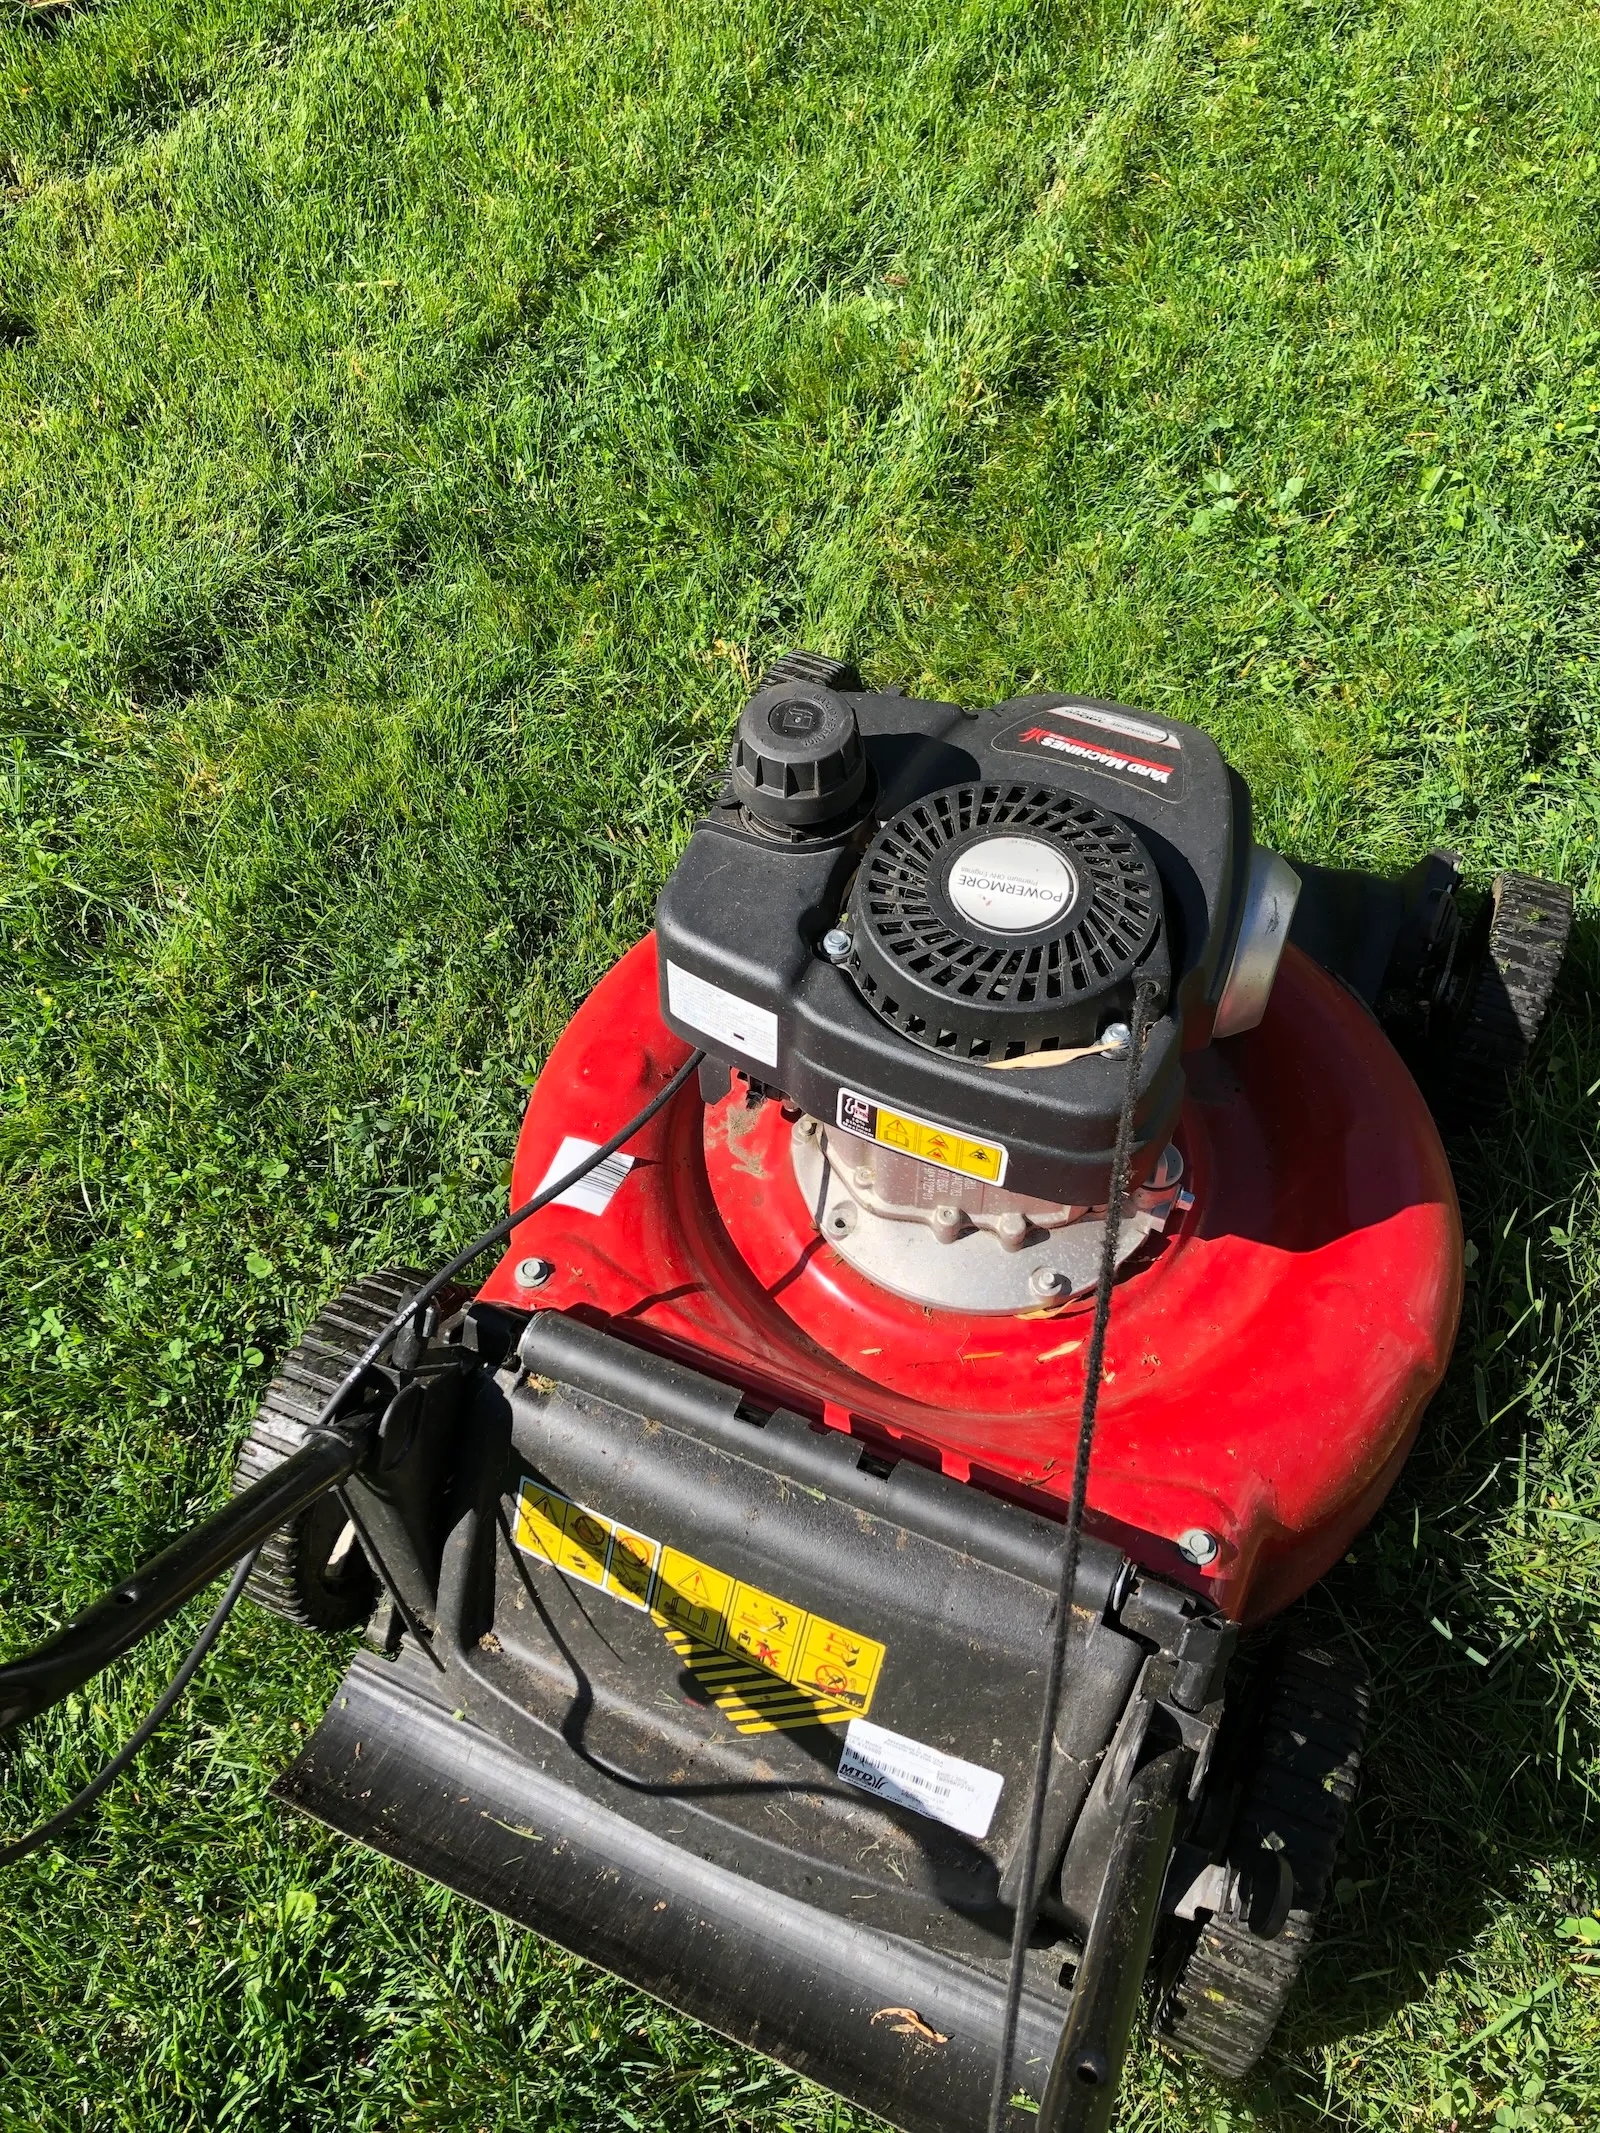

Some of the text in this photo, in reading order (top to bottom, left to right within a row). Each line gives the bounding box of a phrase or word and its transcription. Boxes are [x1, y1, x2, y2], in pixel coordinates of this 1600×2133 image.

[1040, 735, 1170, 784] YARD MACHINES
[957, 875, 1063, 902] POWERMORE
[960, 866, 1039, 887] Premium OHV Engines
[839, 1763, 873, 1785] MTD
